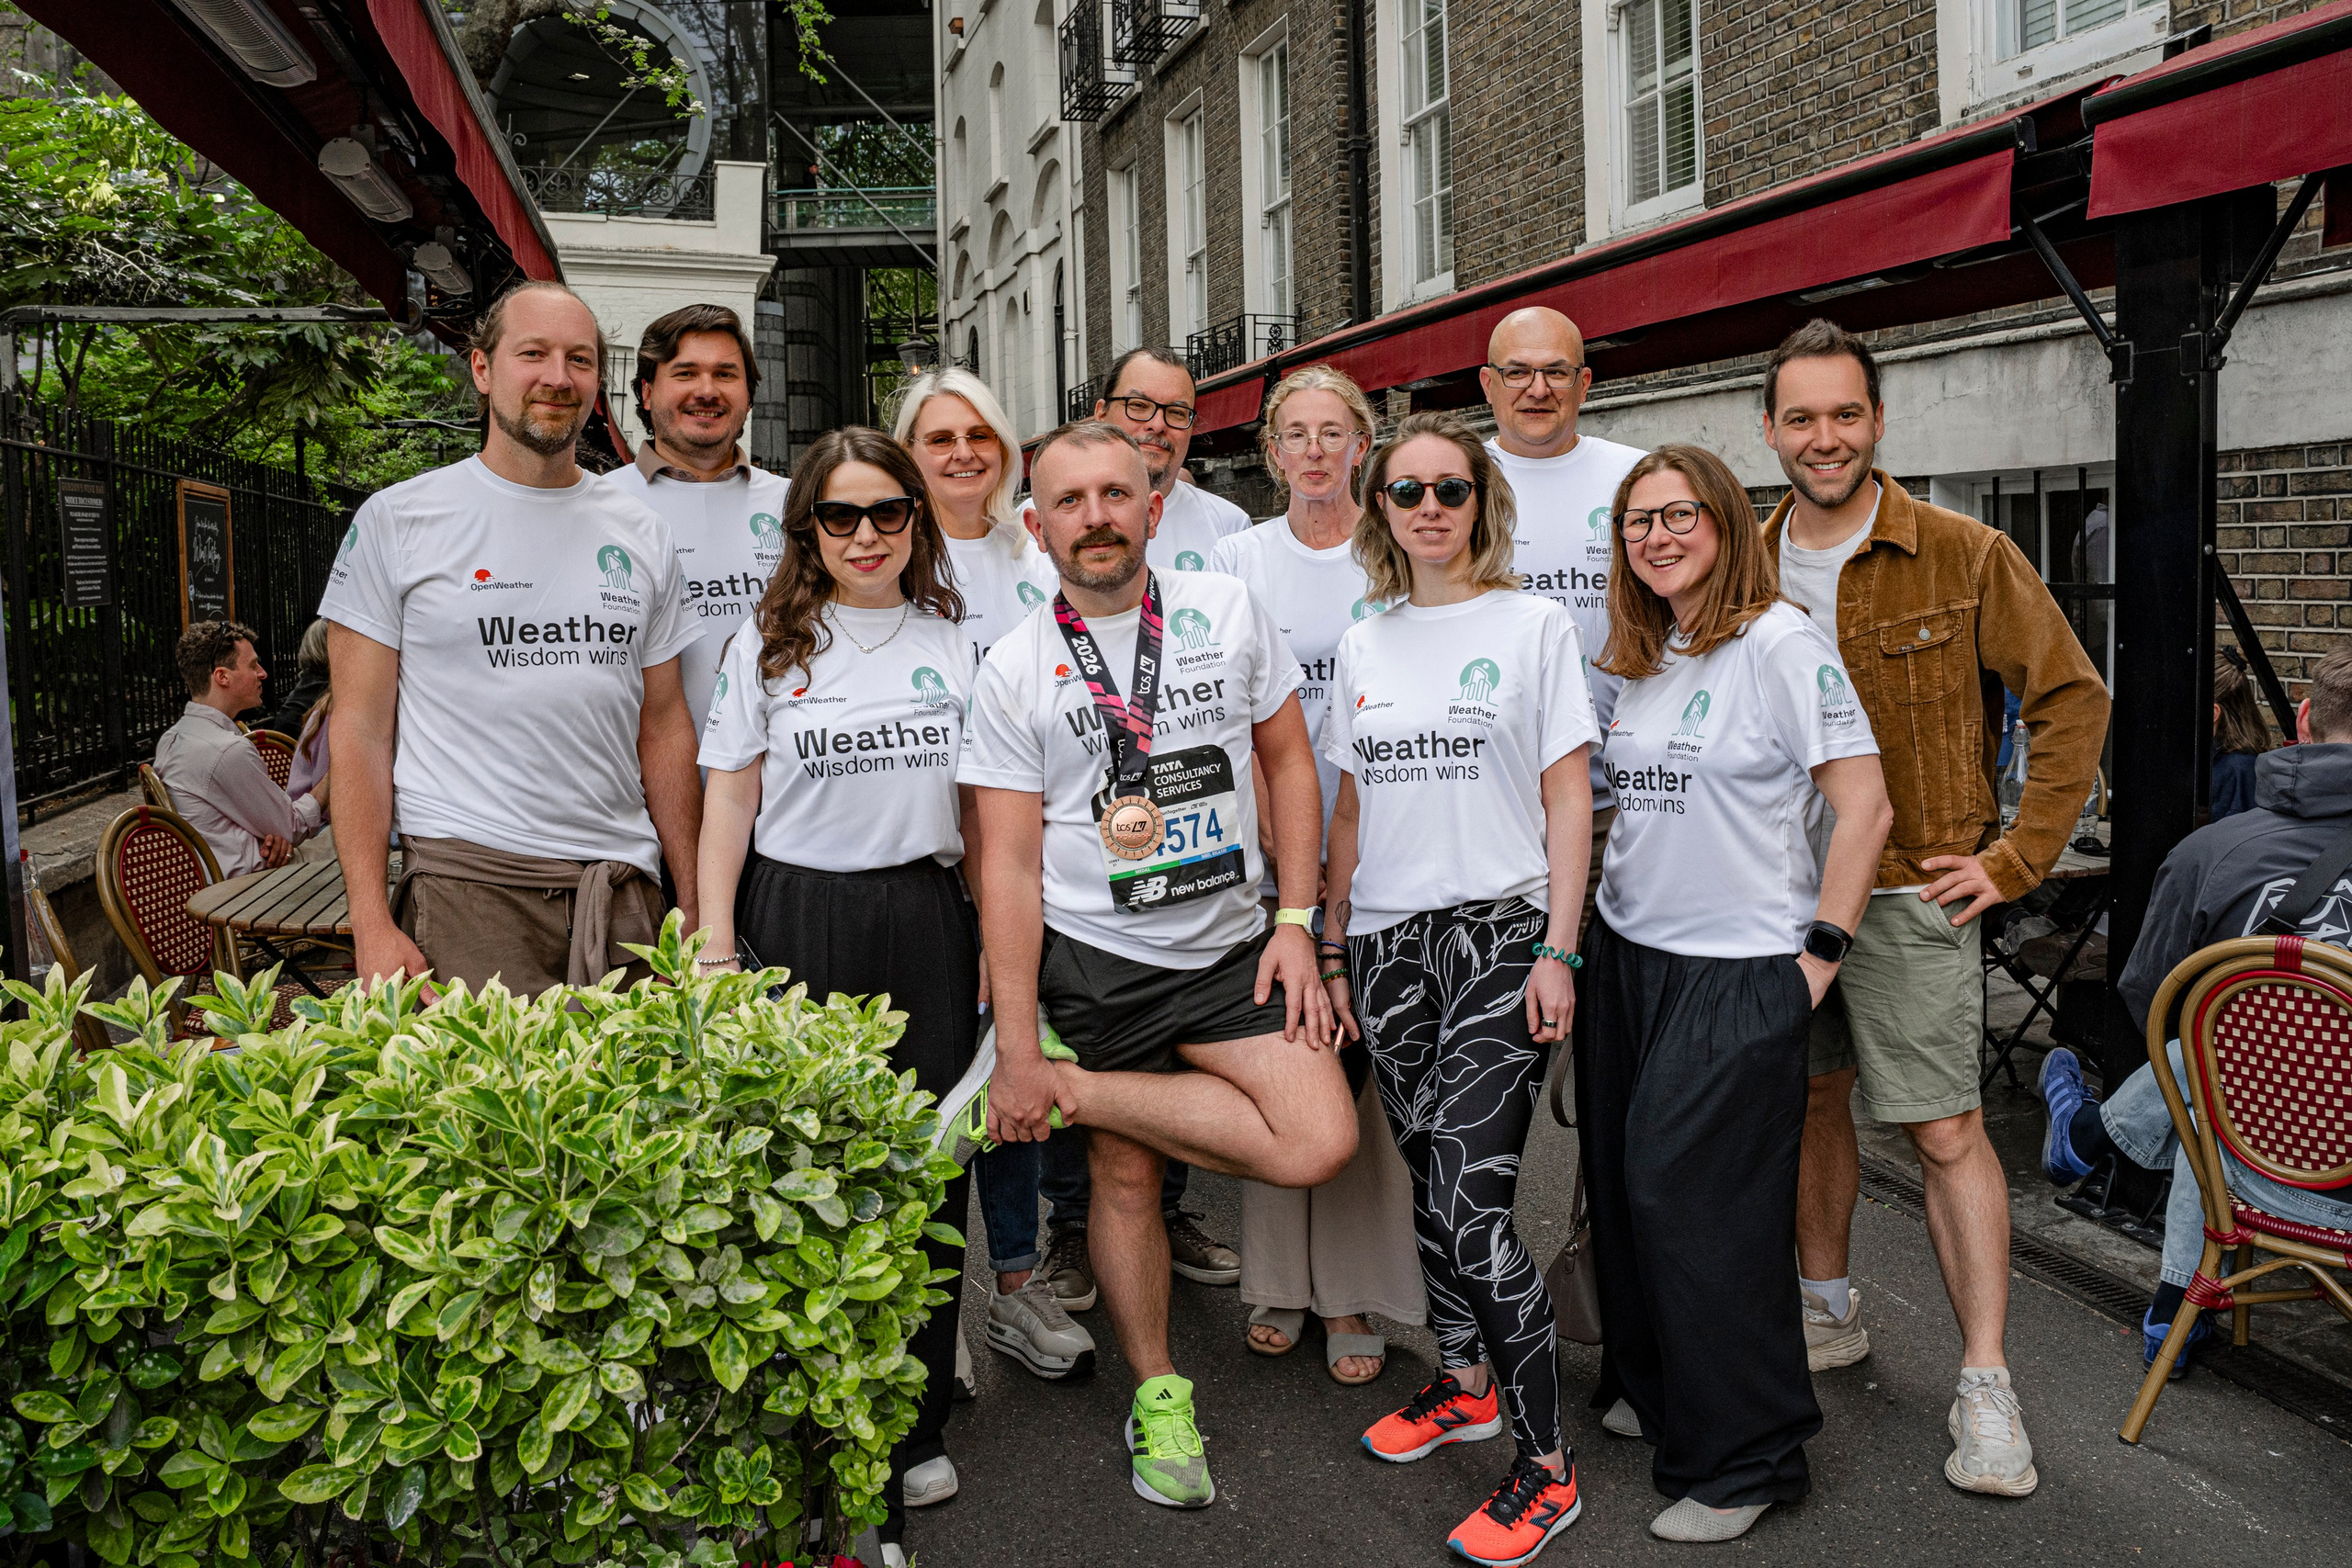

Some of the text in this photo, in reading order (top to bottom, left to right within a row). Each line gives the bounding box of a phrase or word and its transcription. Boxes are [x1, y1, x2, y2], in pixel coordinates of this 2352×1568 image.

[1586, 546, 1612, 555] Weat
[470, 581, 534, 592] OpenWeather
[687, 572, 764, 598] eath
[1521, 567, 1608, 590] eathe
[600, 592, 640, 607] Weather
[1575, 592, 1608, 608] win
[603, 603, 641, 615] Foundation
[697, 601, 741, 617] dom
[478, 615, 638, 646] Weather
[487, 647, 628, 668] Wisdom wins
[1071, 636, 1102, 675] 2026
[1176, 651, 1224, 667] Weather
[1180, 660, 1227, 674] Foundation
[788, 696, 847, 707] OpenWeather
[1177, 706, 1226, 729] wins
[1448, 705, 1497, 721] Weather
[1822, 709, 1856, 719] Weather
[1448, 716, 1493, 729] Foundation
[794, 721, 949, 760] Weather
[1352, 730, 1486, 763] Weather
[1668, 740, 1702, 753] Weather
[804, 749, 949, 779] Wisdom wins
[1667, 752, 1699, 762] Foundation
[1151, 761, 1183, 774] TATA
[1154, 763, 1221, 786] CONSULTANCY
[1436, 761, 1479, 781] wins
[1604, 762, 1692, 794] Weather
[1157, 780, 1203, 798] SERVICES
[1161, 807, 1187, 816] unTogether
[1171, 883, 1194, 897] new
[1196, 870, 1235, 890] balance
